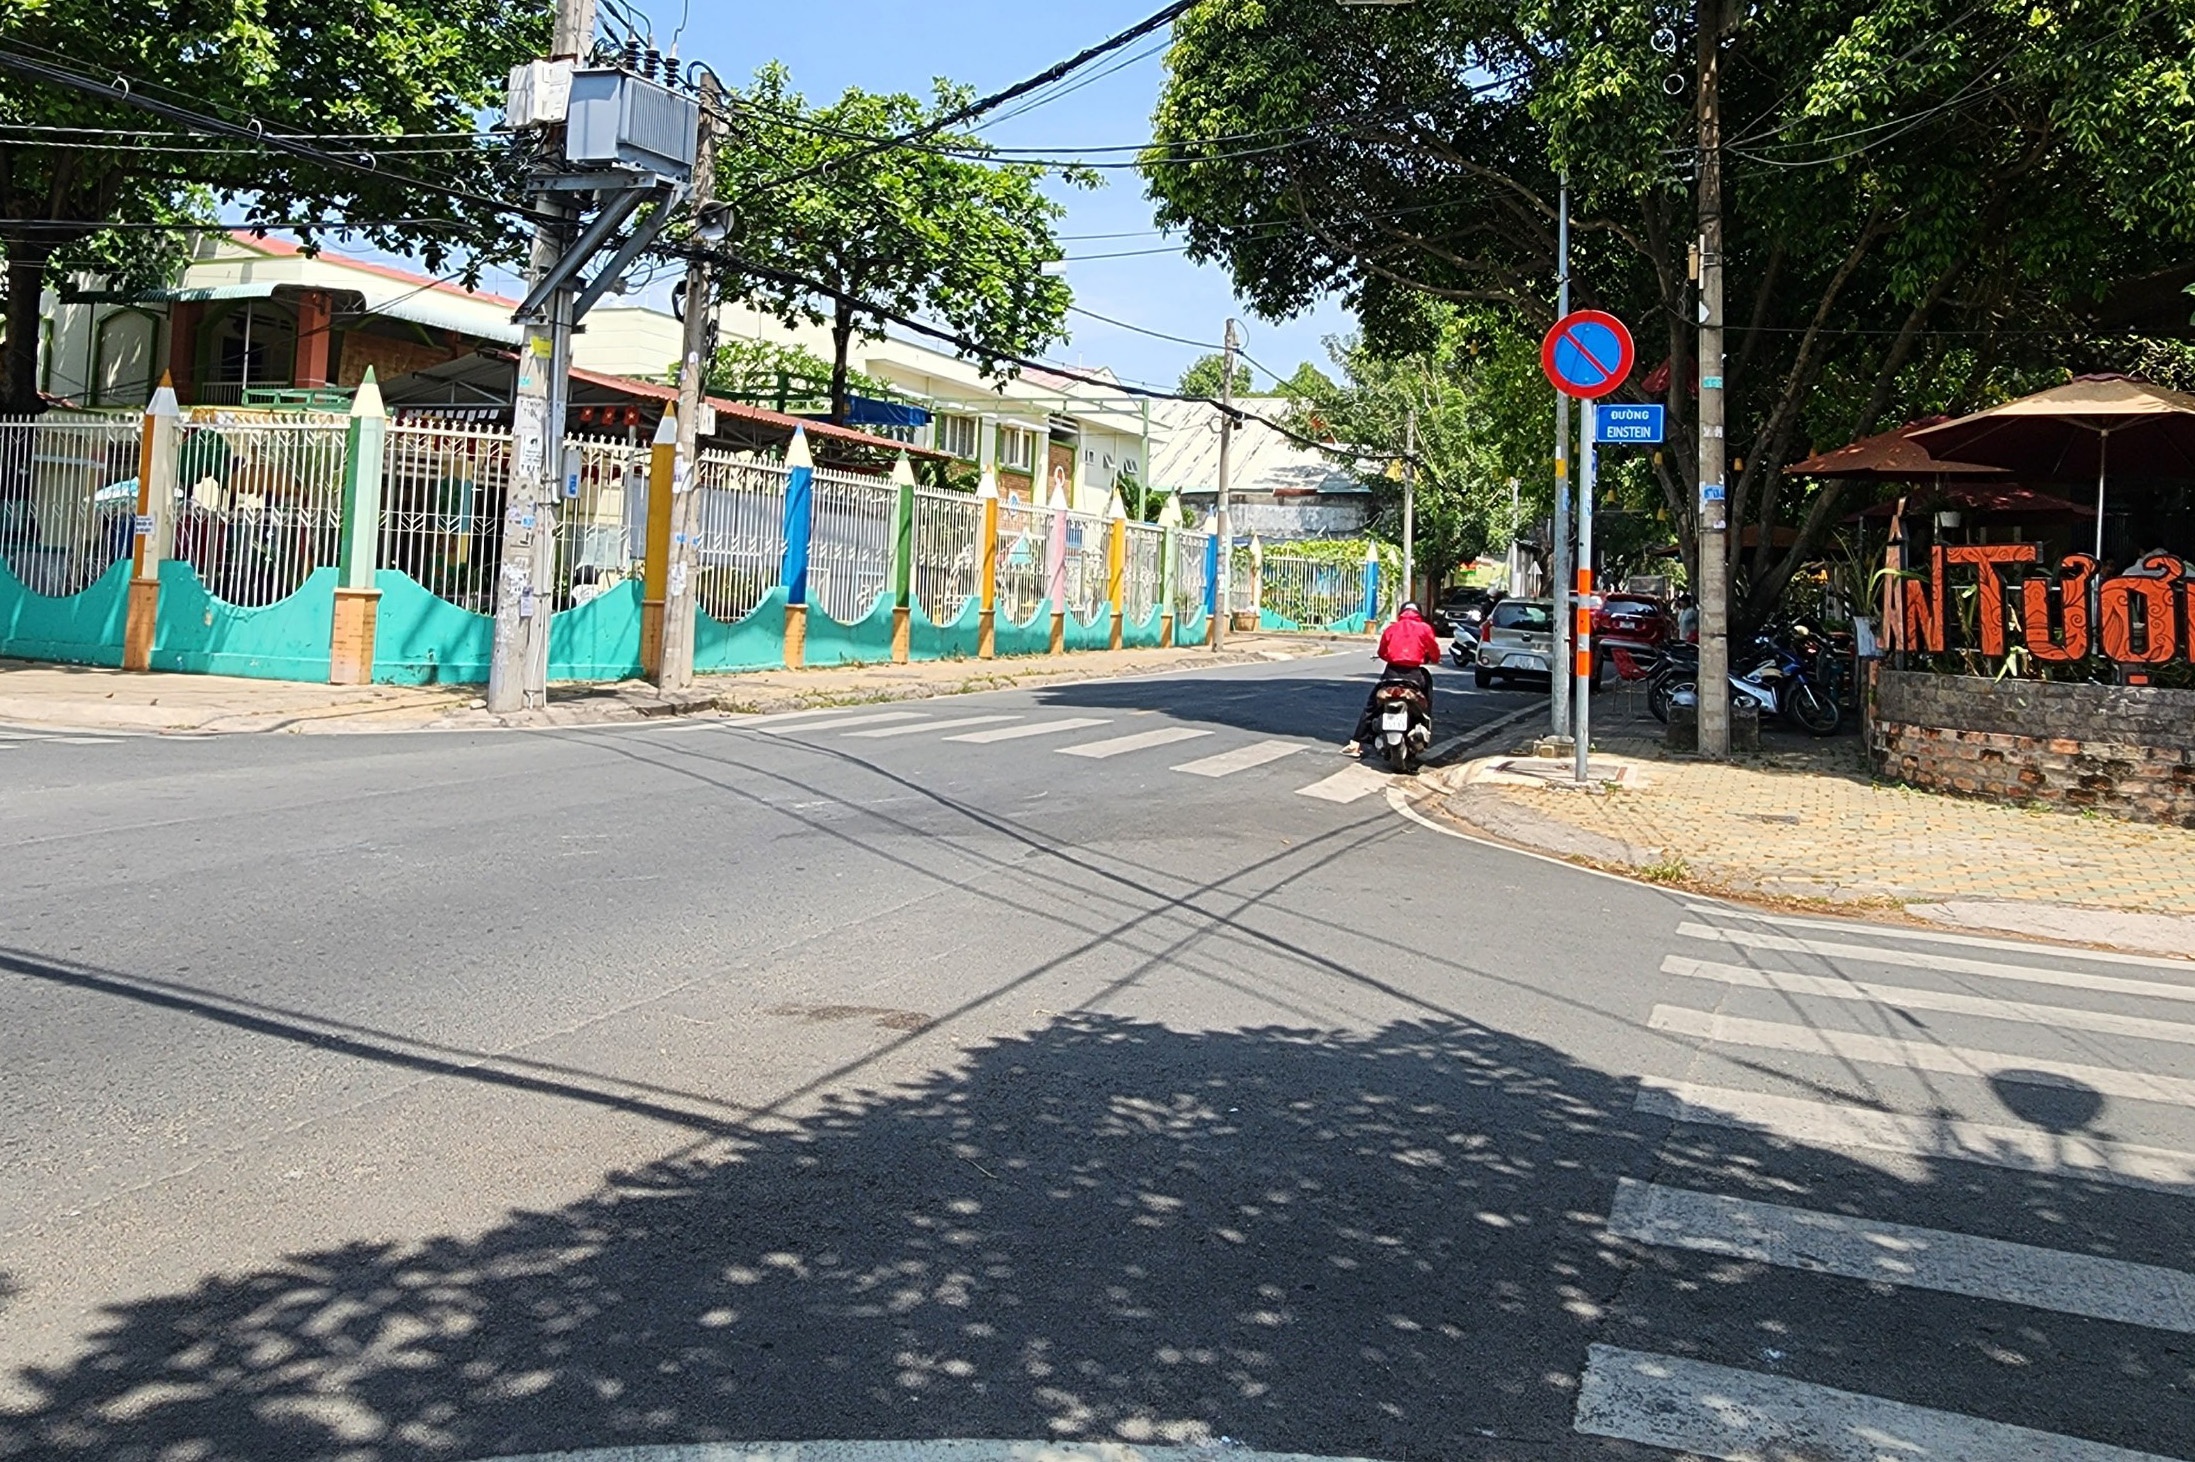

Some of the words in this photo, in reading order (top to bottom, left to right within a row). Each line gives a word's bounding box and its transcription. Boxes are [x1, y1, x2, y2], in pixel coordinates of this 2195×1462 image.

[1610, 409, 1649, 420] ĐƯỜNG
[1607, 426, 1651, 438] EINSTEIN
[1946, 541, 2195, 686] TƯỢ
